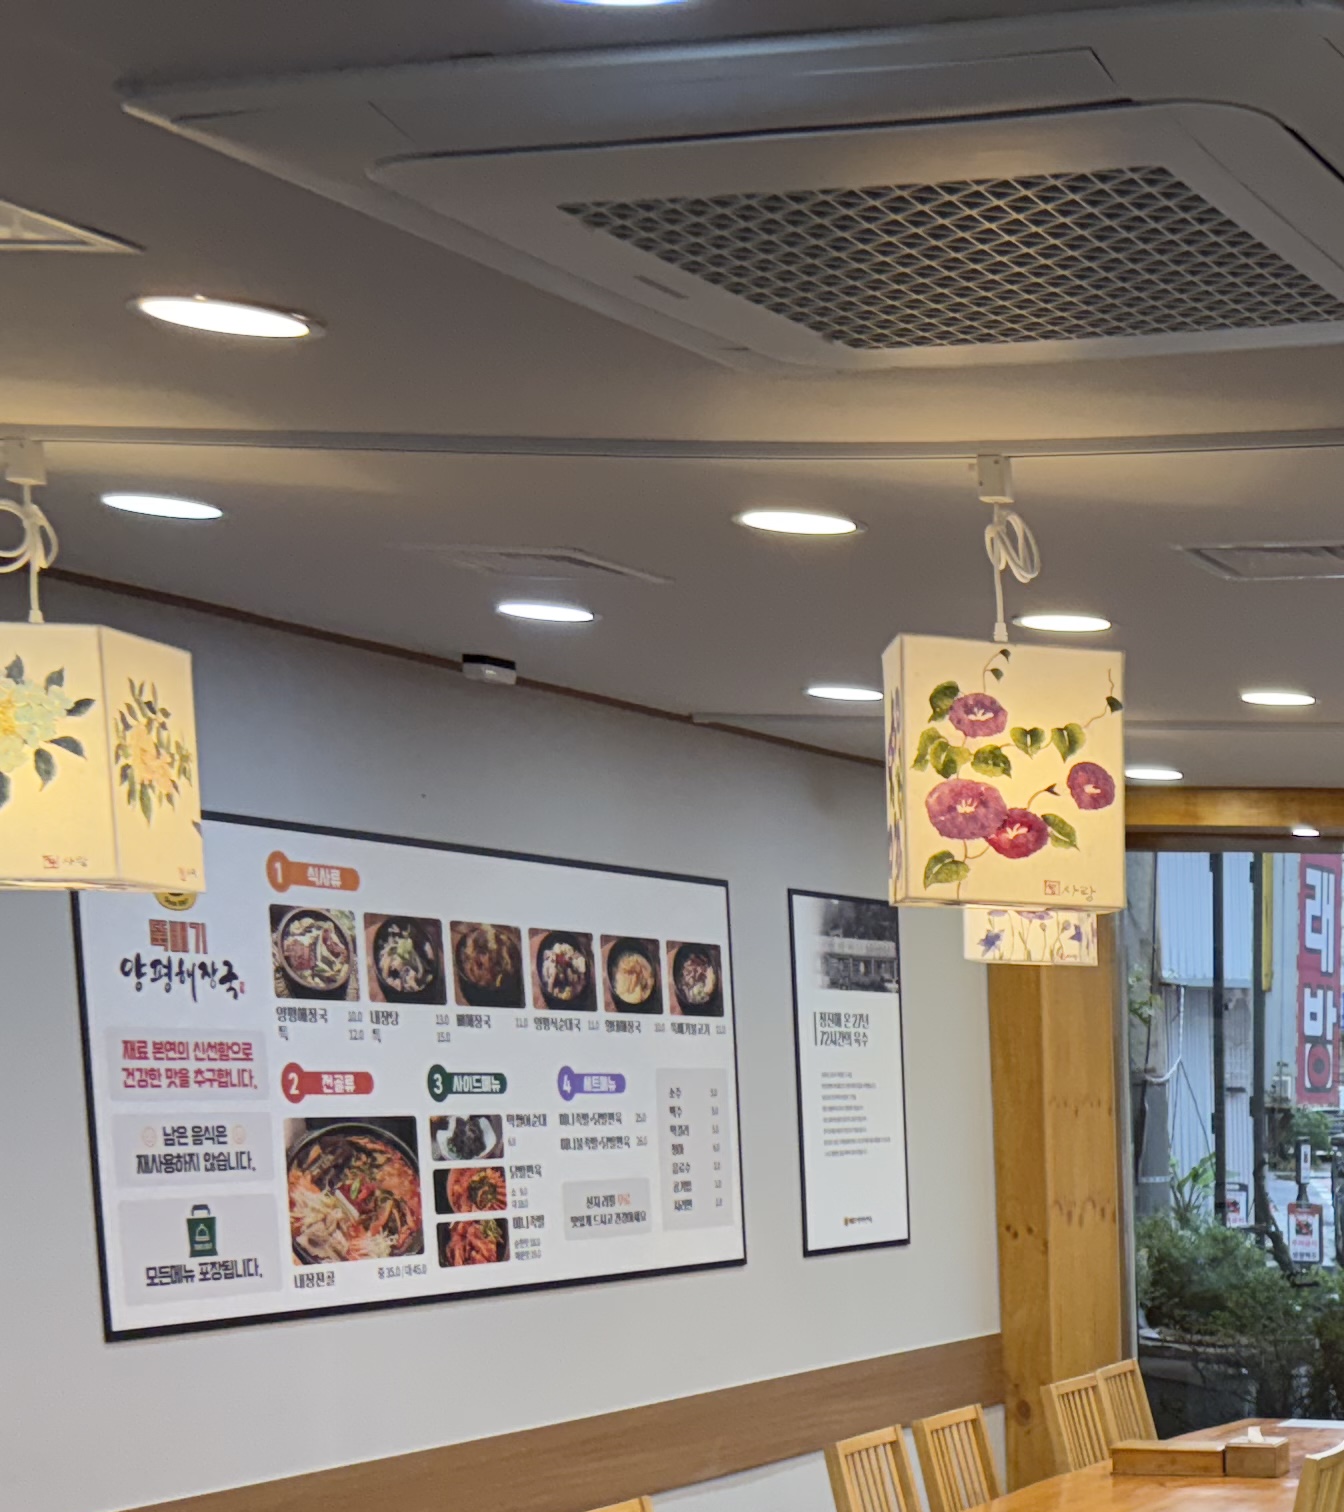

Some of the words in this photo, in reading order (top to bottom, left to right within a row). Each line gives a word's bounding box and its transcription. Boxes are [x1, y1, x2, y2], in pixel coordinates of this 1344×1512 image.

[273, 861, 283, 883] 1
[120, 952, 239, 1002] 양평해장국
[122, 1040, 150, 1060] 재료
[152, 1040, 190, 1060] 본연의
[193, 1041, 254, 1061] 신선함으로
[121, 1068, 162, 1088] 건강한
[165, 1068, 190, 1088] 맛을
[193, 1068, 258, 1089] 추구합니다.
[288, 1073, 299, 1094] 2
[433, 1074, 443, 1094] 3
[452, 1075, 501, 1093] 사이드메뉴
[562, 1074, 572, 1093] 4
[162, 1126, 189, 1146] 남은
[191, 1125, 228, 1145] 음식은
[136, 1152, 200, 1174] 재사용하지
[203, 1150, 256, 1172] 않습니다.
[145, 1264, 196, 1286] 모든메뉴
[198, 1258, 264, 1282] 포장됩니다.
